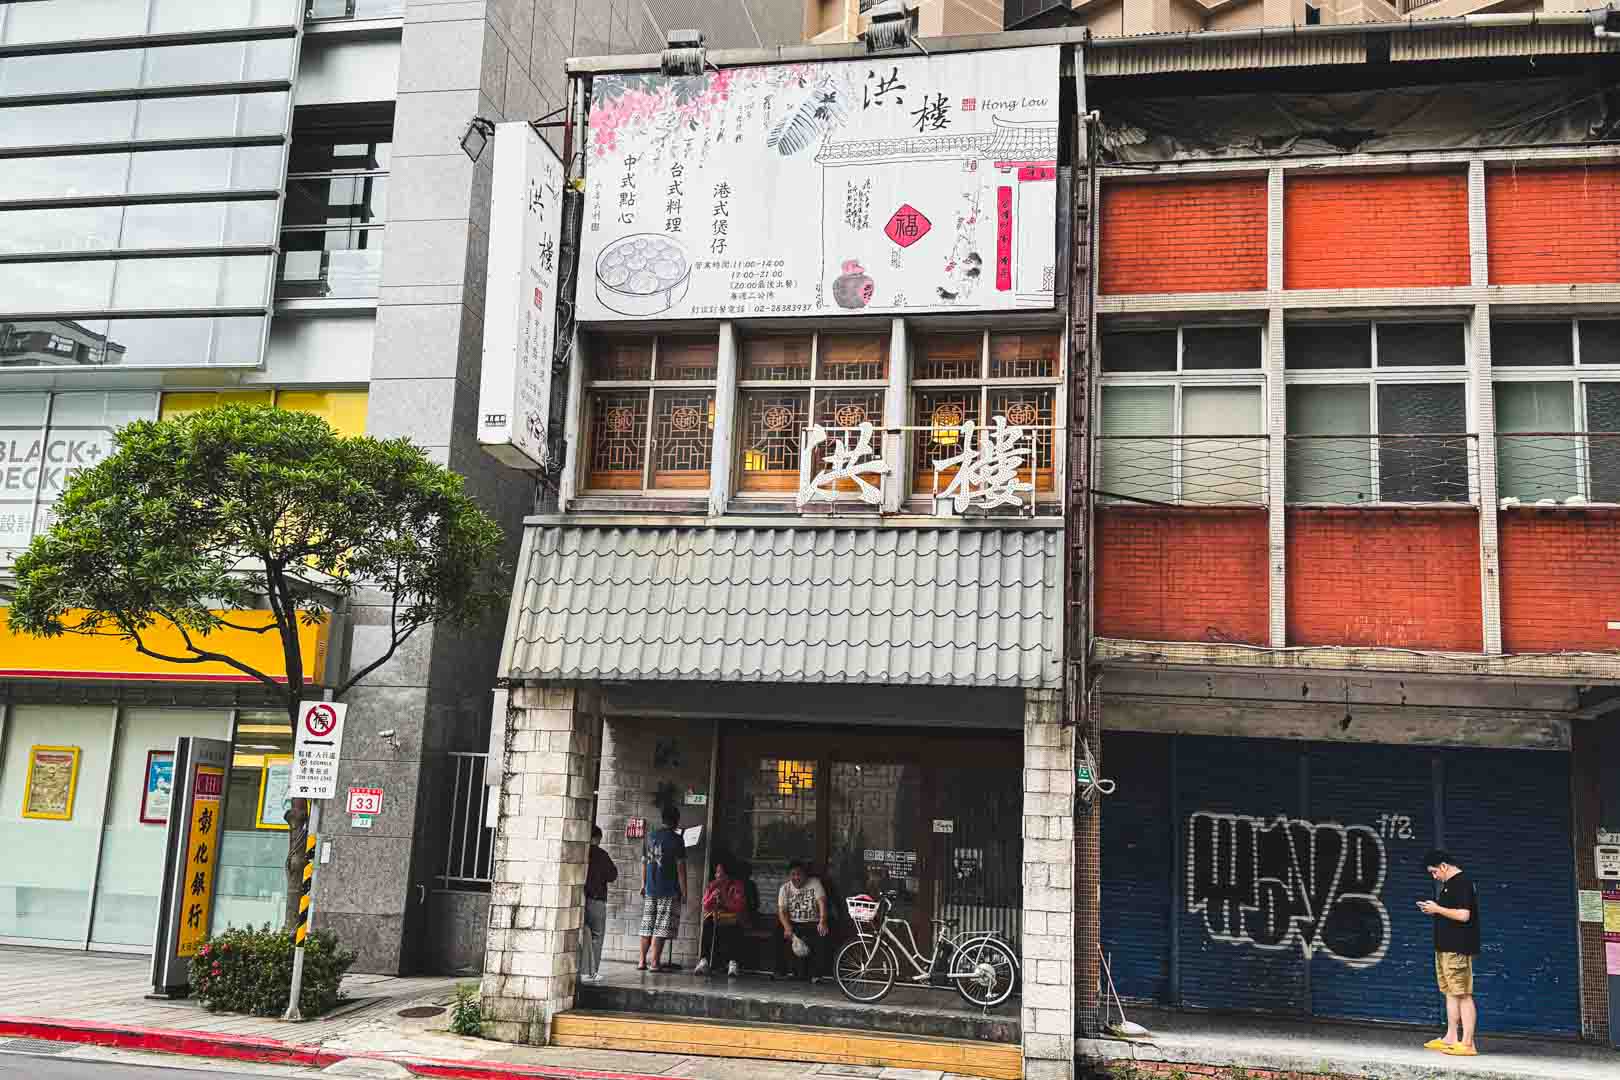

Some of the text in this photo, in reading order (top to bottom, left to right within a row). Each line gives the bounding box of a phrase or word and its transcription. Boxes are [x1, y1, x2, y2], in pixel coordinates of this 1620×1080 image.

[863, 67, 952, 133] 洪樓
[981, 98, 1018, 111] Hong
[1021, 97, 1048, 108] Lou
[617, 154, 637, 224] 中式點心
[665, 162, 685, 233] 台式料理
[711, 182, 732, 254] 港式煲仔
[895, 214, 919, 237] 福
[356, 797, 373, 810] 33
[187, 807, 213, 929] 彰化銀行
